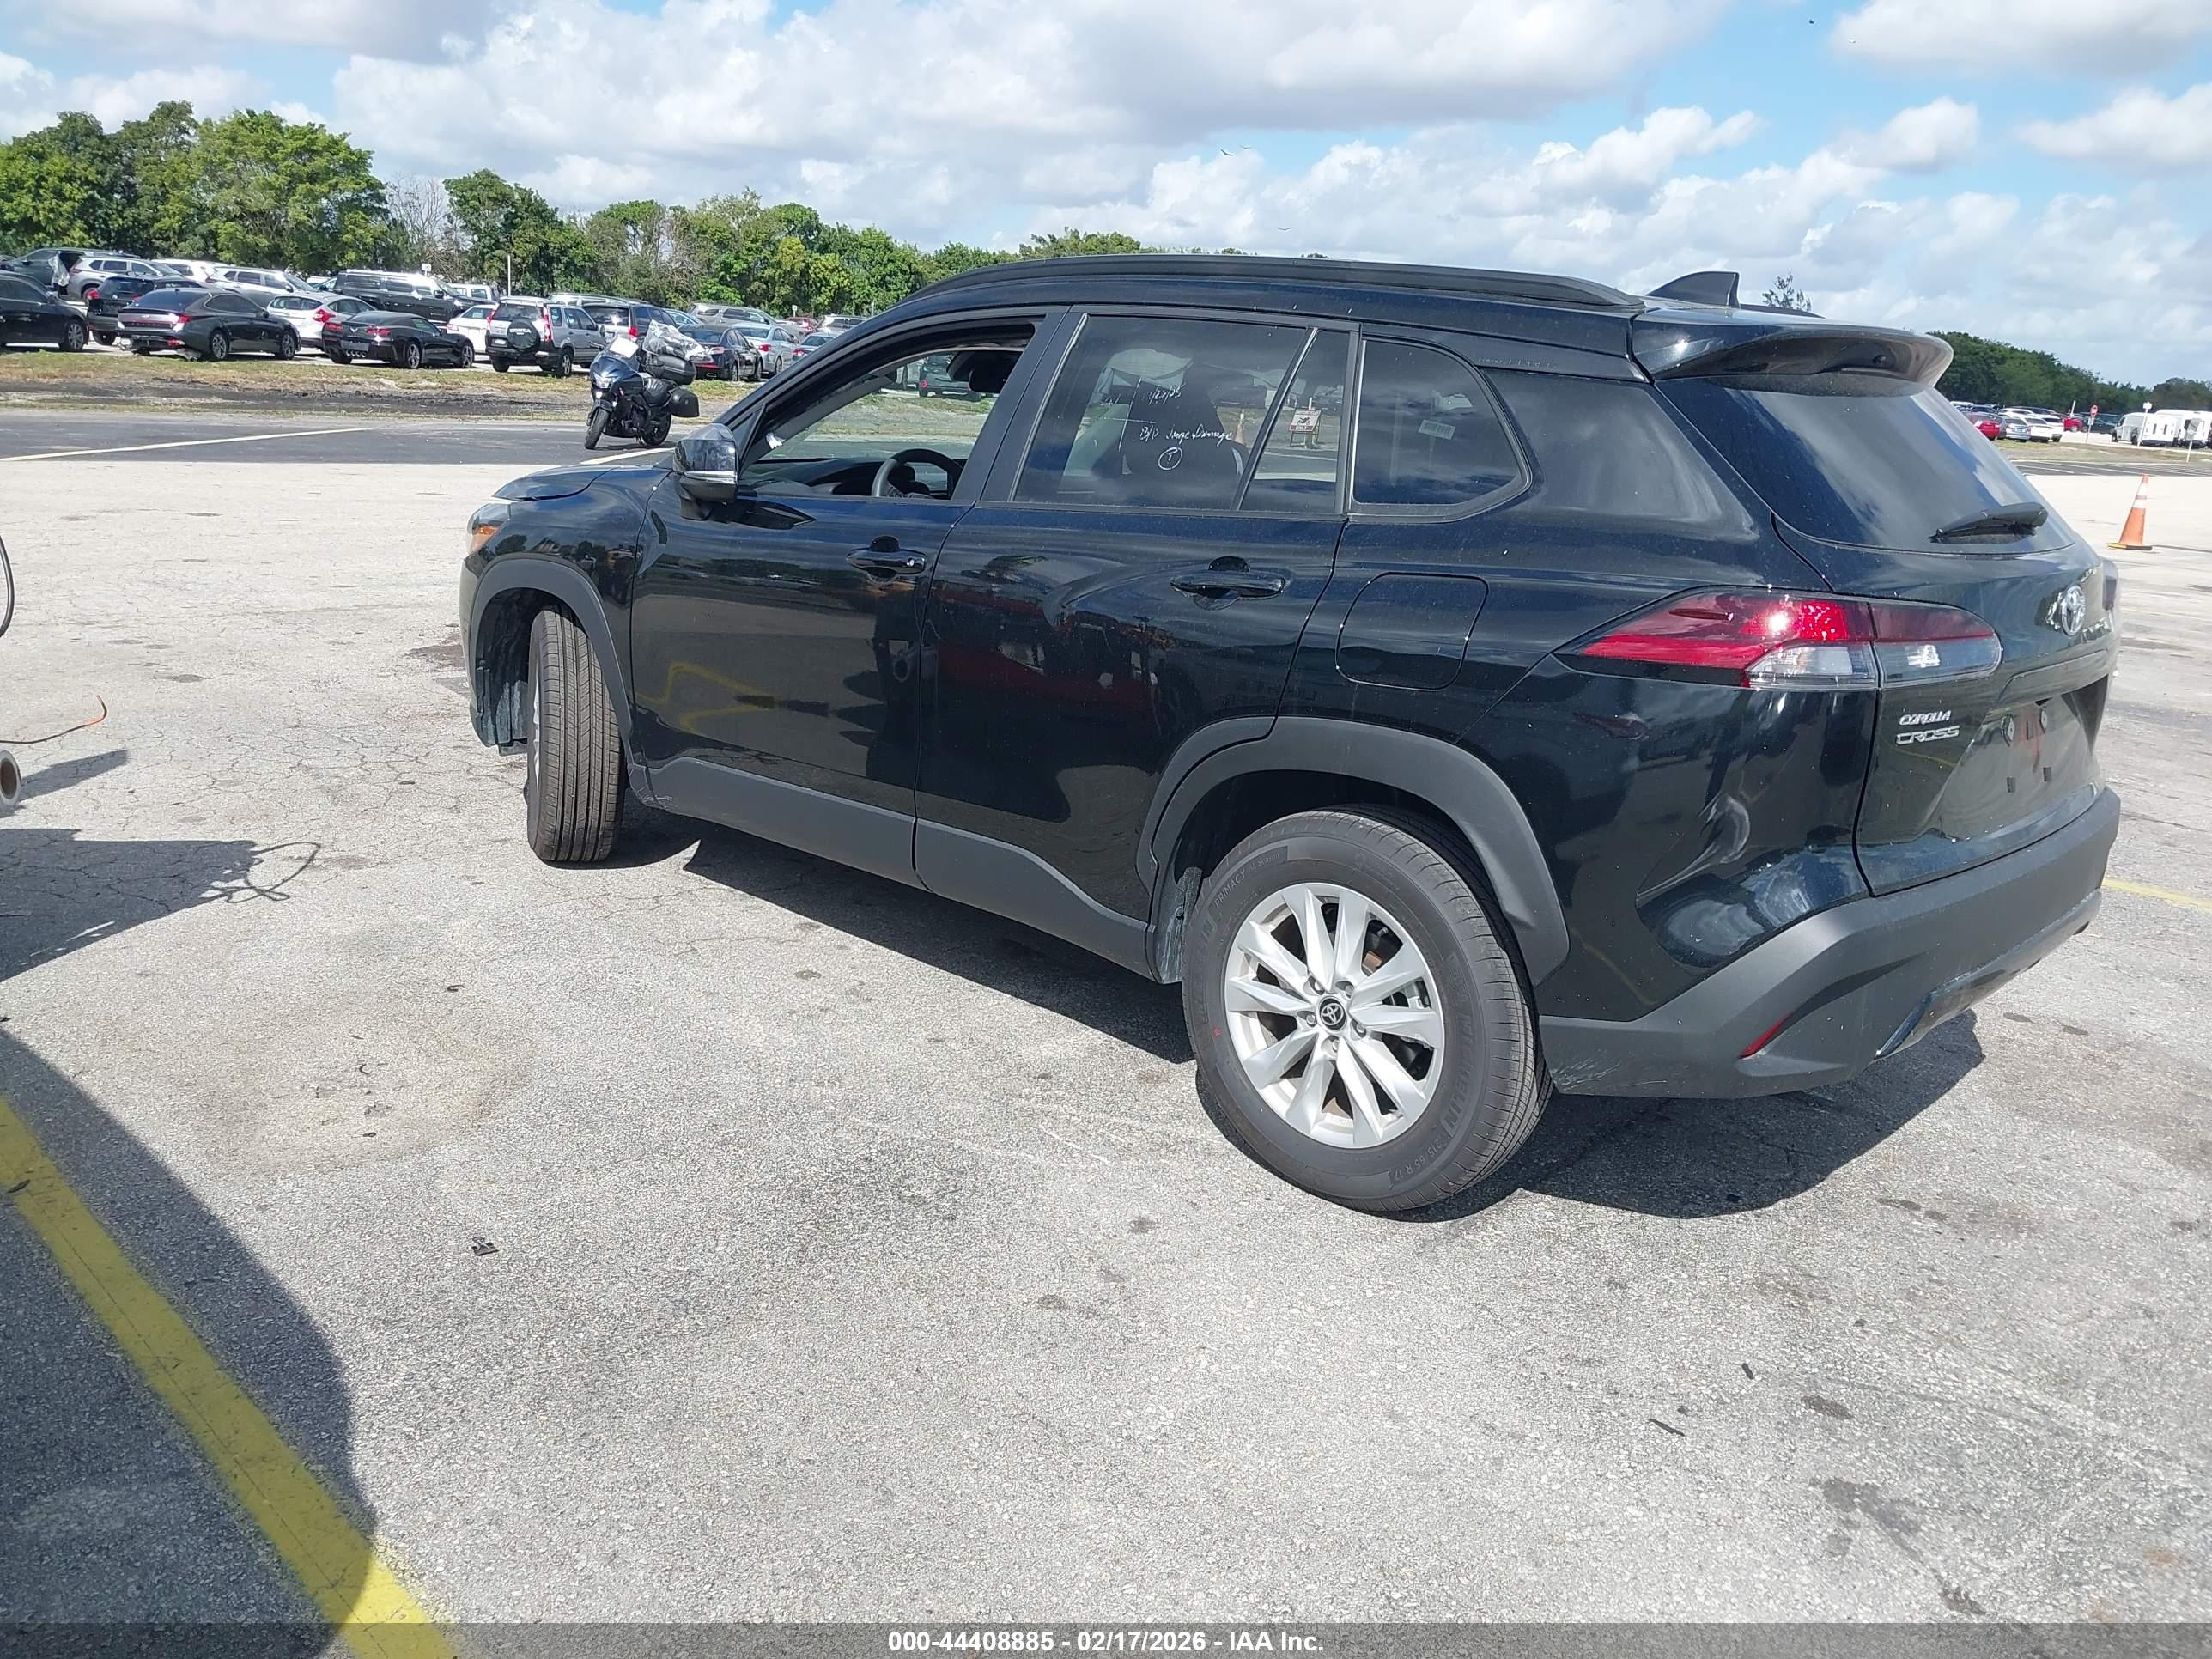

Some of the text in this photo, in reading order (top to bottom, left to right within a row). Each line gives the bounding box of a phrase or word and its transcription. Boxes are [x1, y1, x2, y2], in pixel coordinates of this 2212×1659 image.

[1899, 710, 1952, 725] COROLLA
[1896, 726, 1960, 744] CROSS
[1214, 869, 1245, 908] PRIMACY
